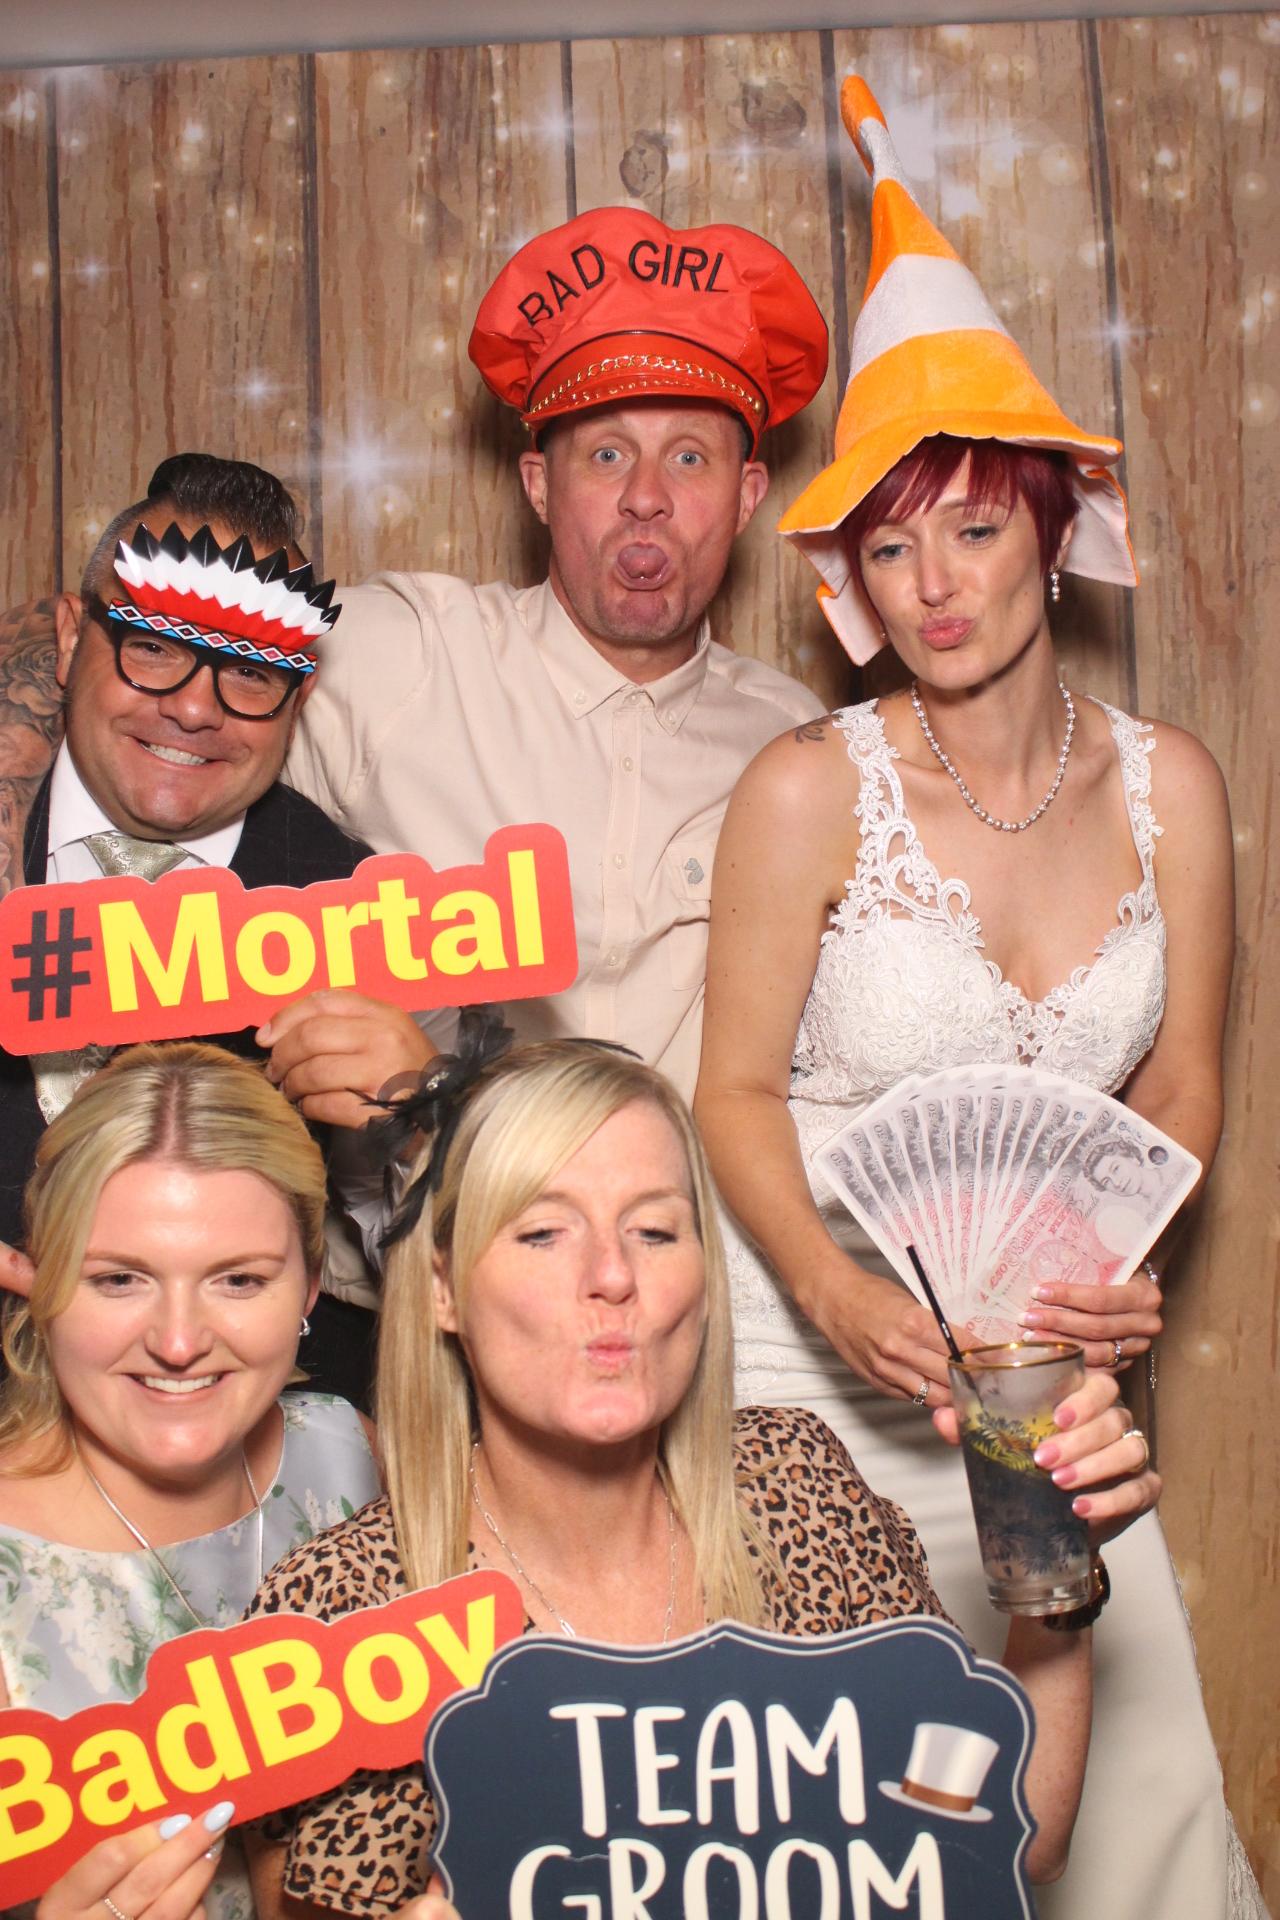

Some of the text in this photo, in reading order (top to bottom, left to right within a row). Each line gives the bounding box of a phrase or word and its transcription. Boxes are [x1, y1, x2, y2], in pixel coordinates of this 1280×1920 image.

[518, 239, 729, 327] BAD GIRL
[11, 850, 545, 1021] #Mortal
[549, 1697, 867, 1838] TEAM
[510, 1832, 945, 1920] GROOM
